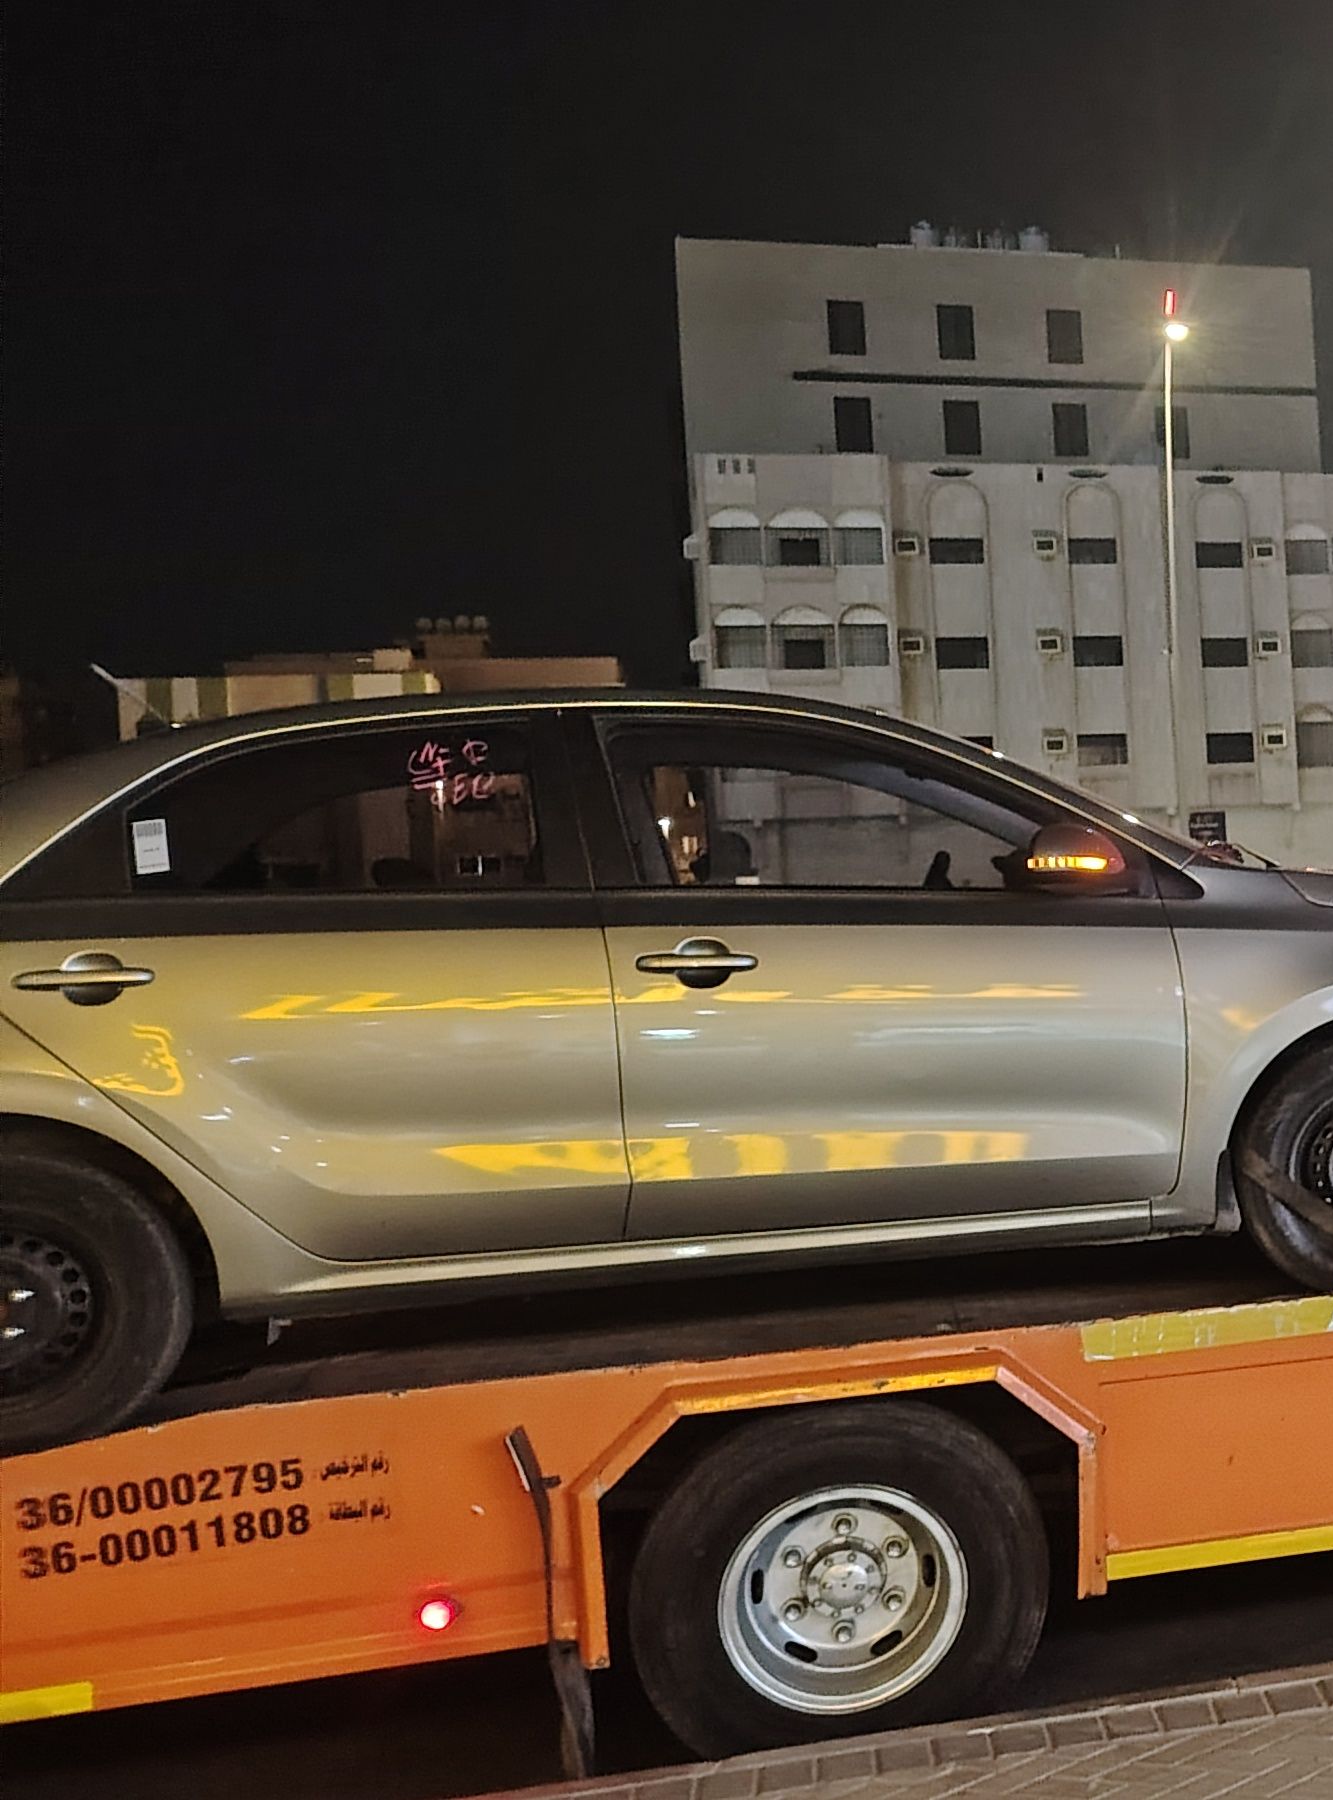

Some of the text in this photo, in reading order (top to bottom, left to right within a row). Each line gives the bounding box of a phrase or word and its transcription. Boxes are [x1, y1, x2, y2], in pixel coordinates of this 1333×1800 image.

[371, 1450, 390, 1477] رقم
[16, 1457, 304, 1531] 36/00002795
[371, 1497, 391, 1524] رقم
[18, 1503, 311, 1580] 36-00011808
